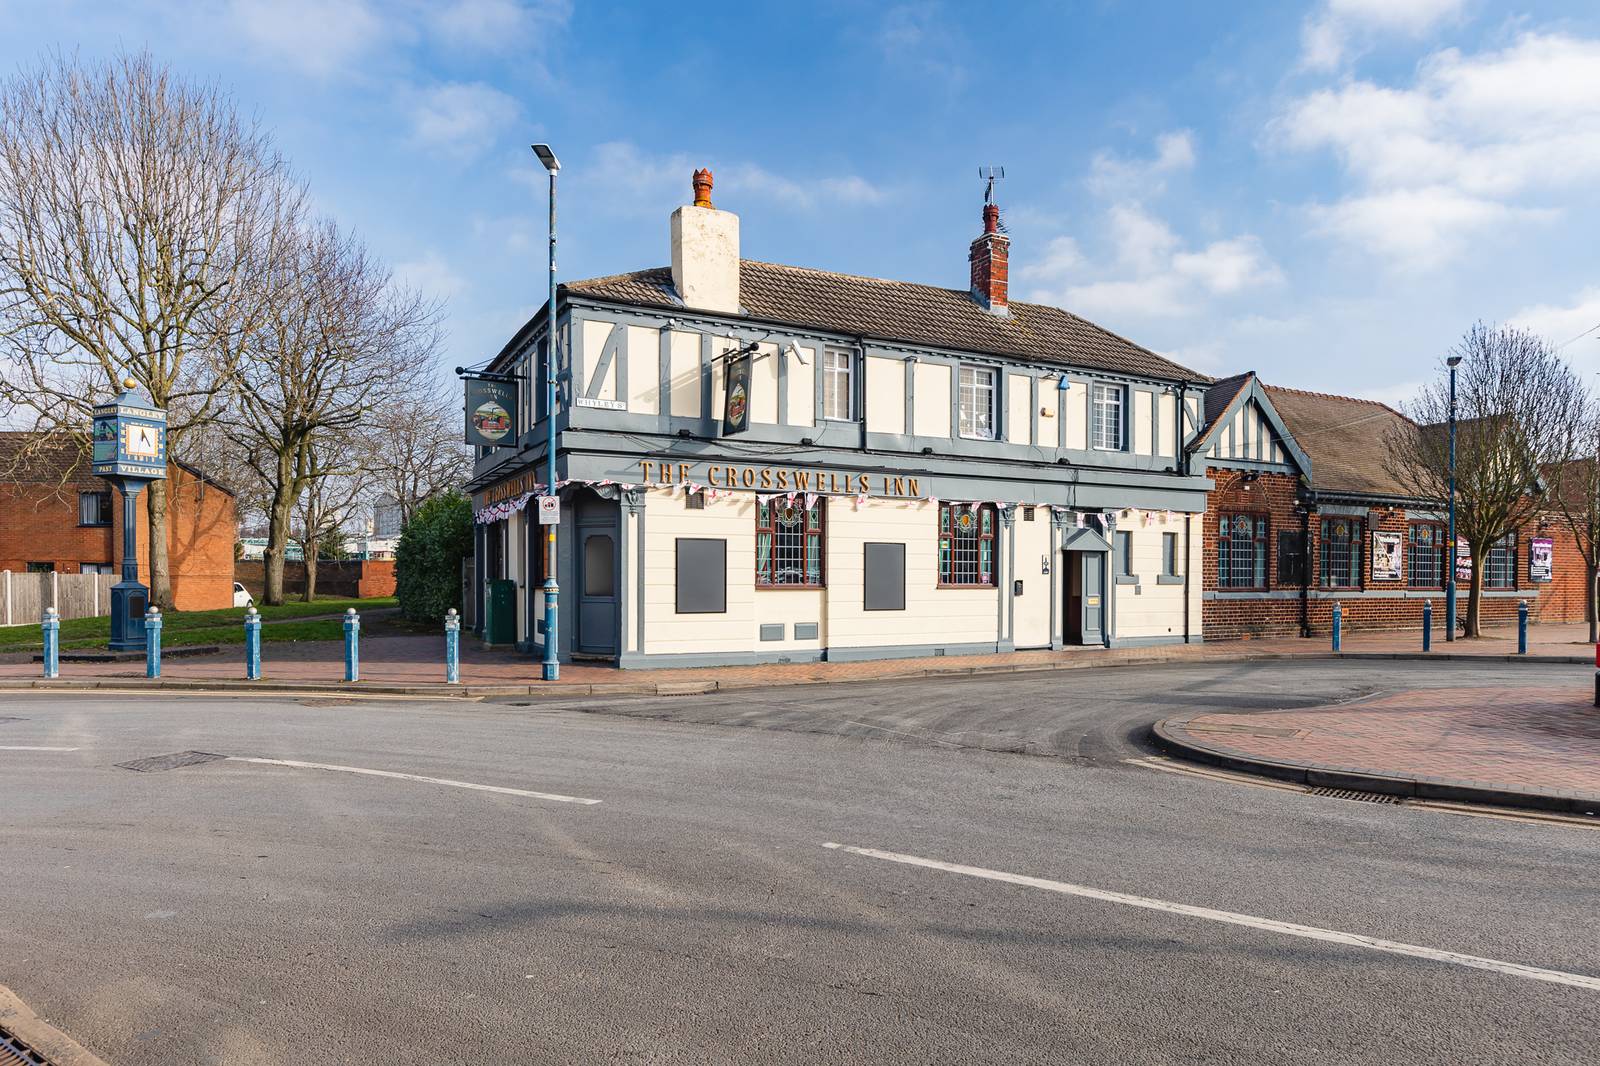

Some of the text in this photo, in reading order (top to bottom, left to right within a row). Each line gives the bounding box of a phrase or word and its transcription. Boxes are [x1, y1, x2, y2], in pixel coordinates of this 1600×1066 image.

[119, 407, 163, 419] LANGLEY
[121, 466, 164, 476] VILLAGE
[638, 461, 920, 496] THE CROSSWELLS INN
